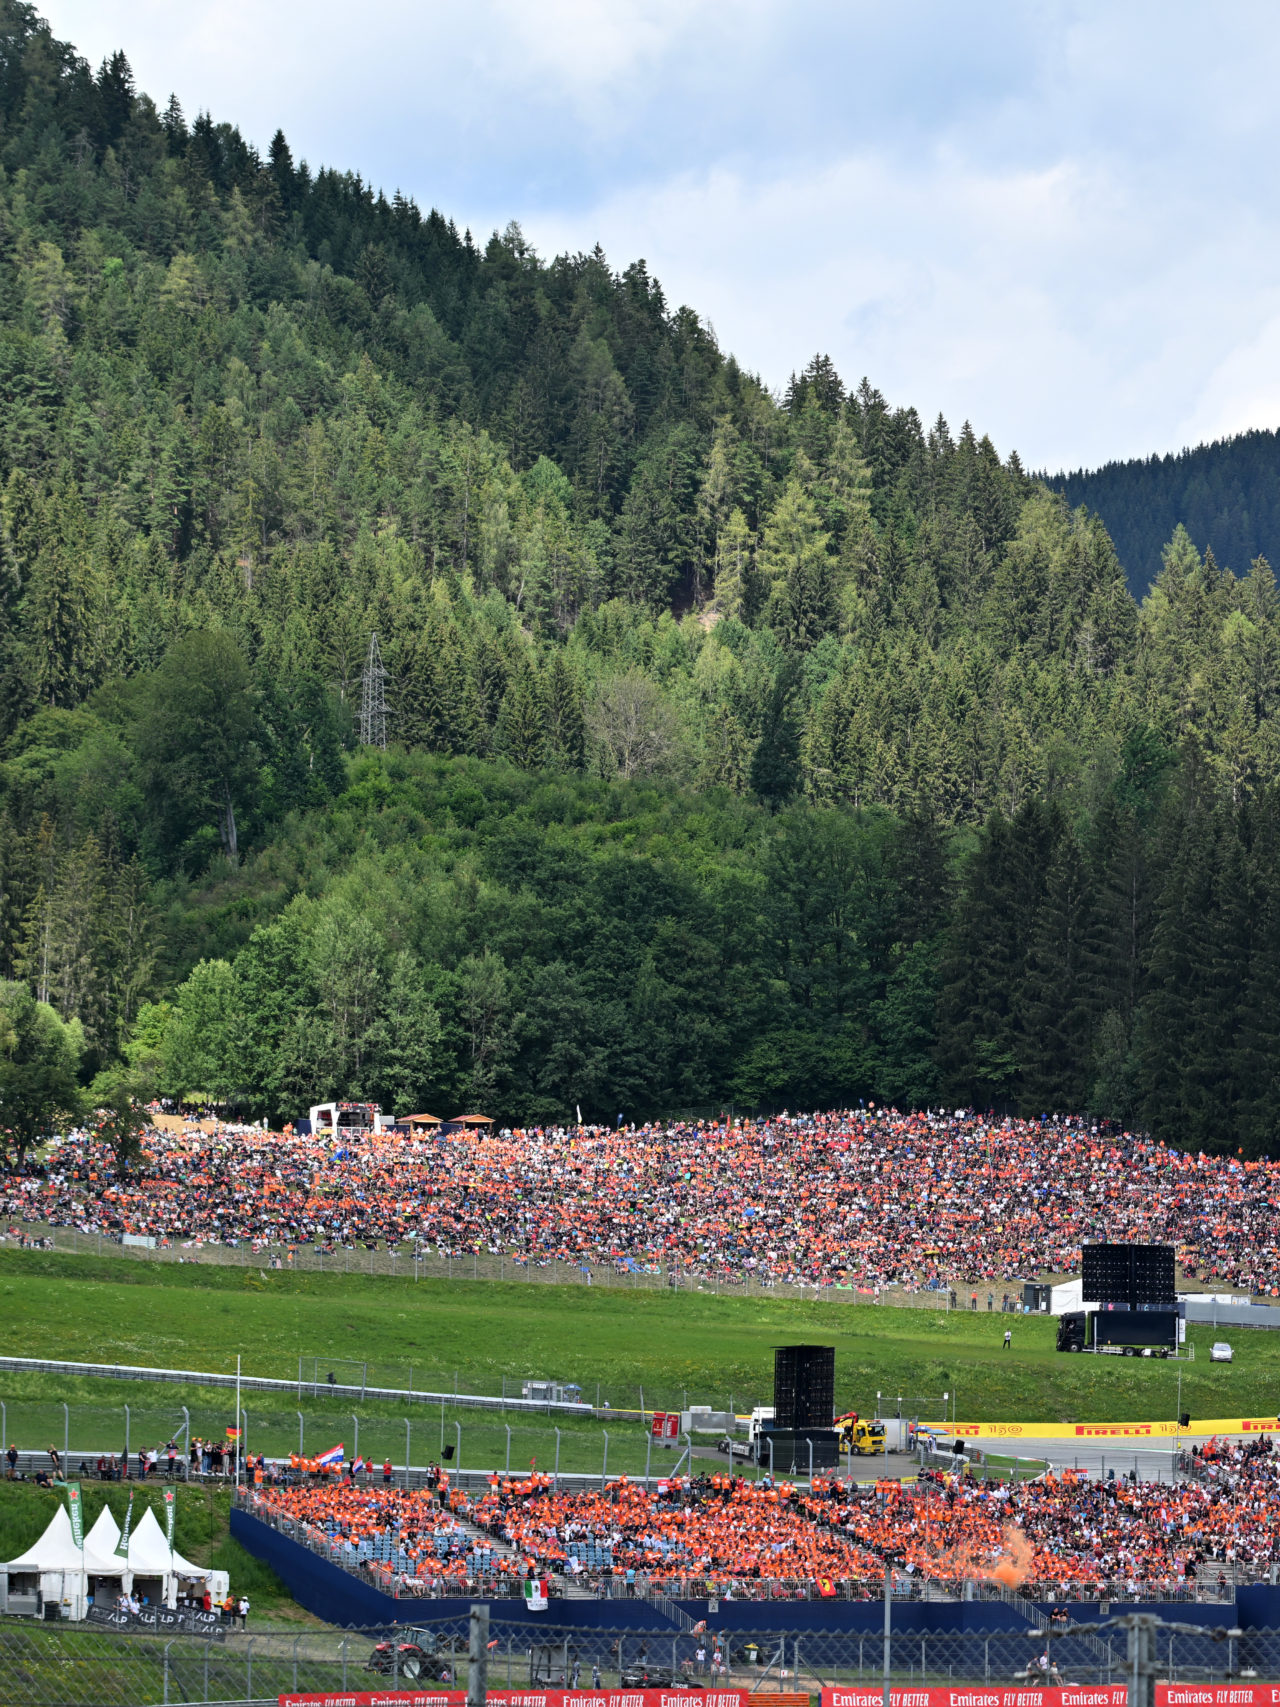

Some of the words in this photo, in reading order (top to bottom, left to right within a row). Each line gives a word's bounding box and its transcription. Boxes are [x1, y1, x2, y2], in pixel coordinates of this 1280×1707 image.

[1075, 1424, 1152, 1435] PIRELLI
[563, 1695, 606, 1707] Emirates
[609, 1695, 620, 1707] FLY
[620, 1694, 644, 1707] BETTER
[660, 1694, 703, 1707] Emirates
[706, 1694, 717, 1707] FLY
[717, 1694, 740, 1707] BETTER
[832, 1693, 884, 1707] Emirates
[889, 1693, 901, 1707] FLY
[902, 1693, 929, 1707] BETTER
[950, 1693, 1000, 1707] Emirates
[1003, 1693, 1016, 1706] FLY
[1017, 1692, 1043, 1706] BETTER
[1061, 1691, 1109, 1705] Emirates
[1112, 1691, 1125, 1705] FLY
[1167, 1690, 1213, 1704] Emirates
[1216, 1690, 1228, 1703] FLY
[1229, 1690, 1253, 1704] BETTER
